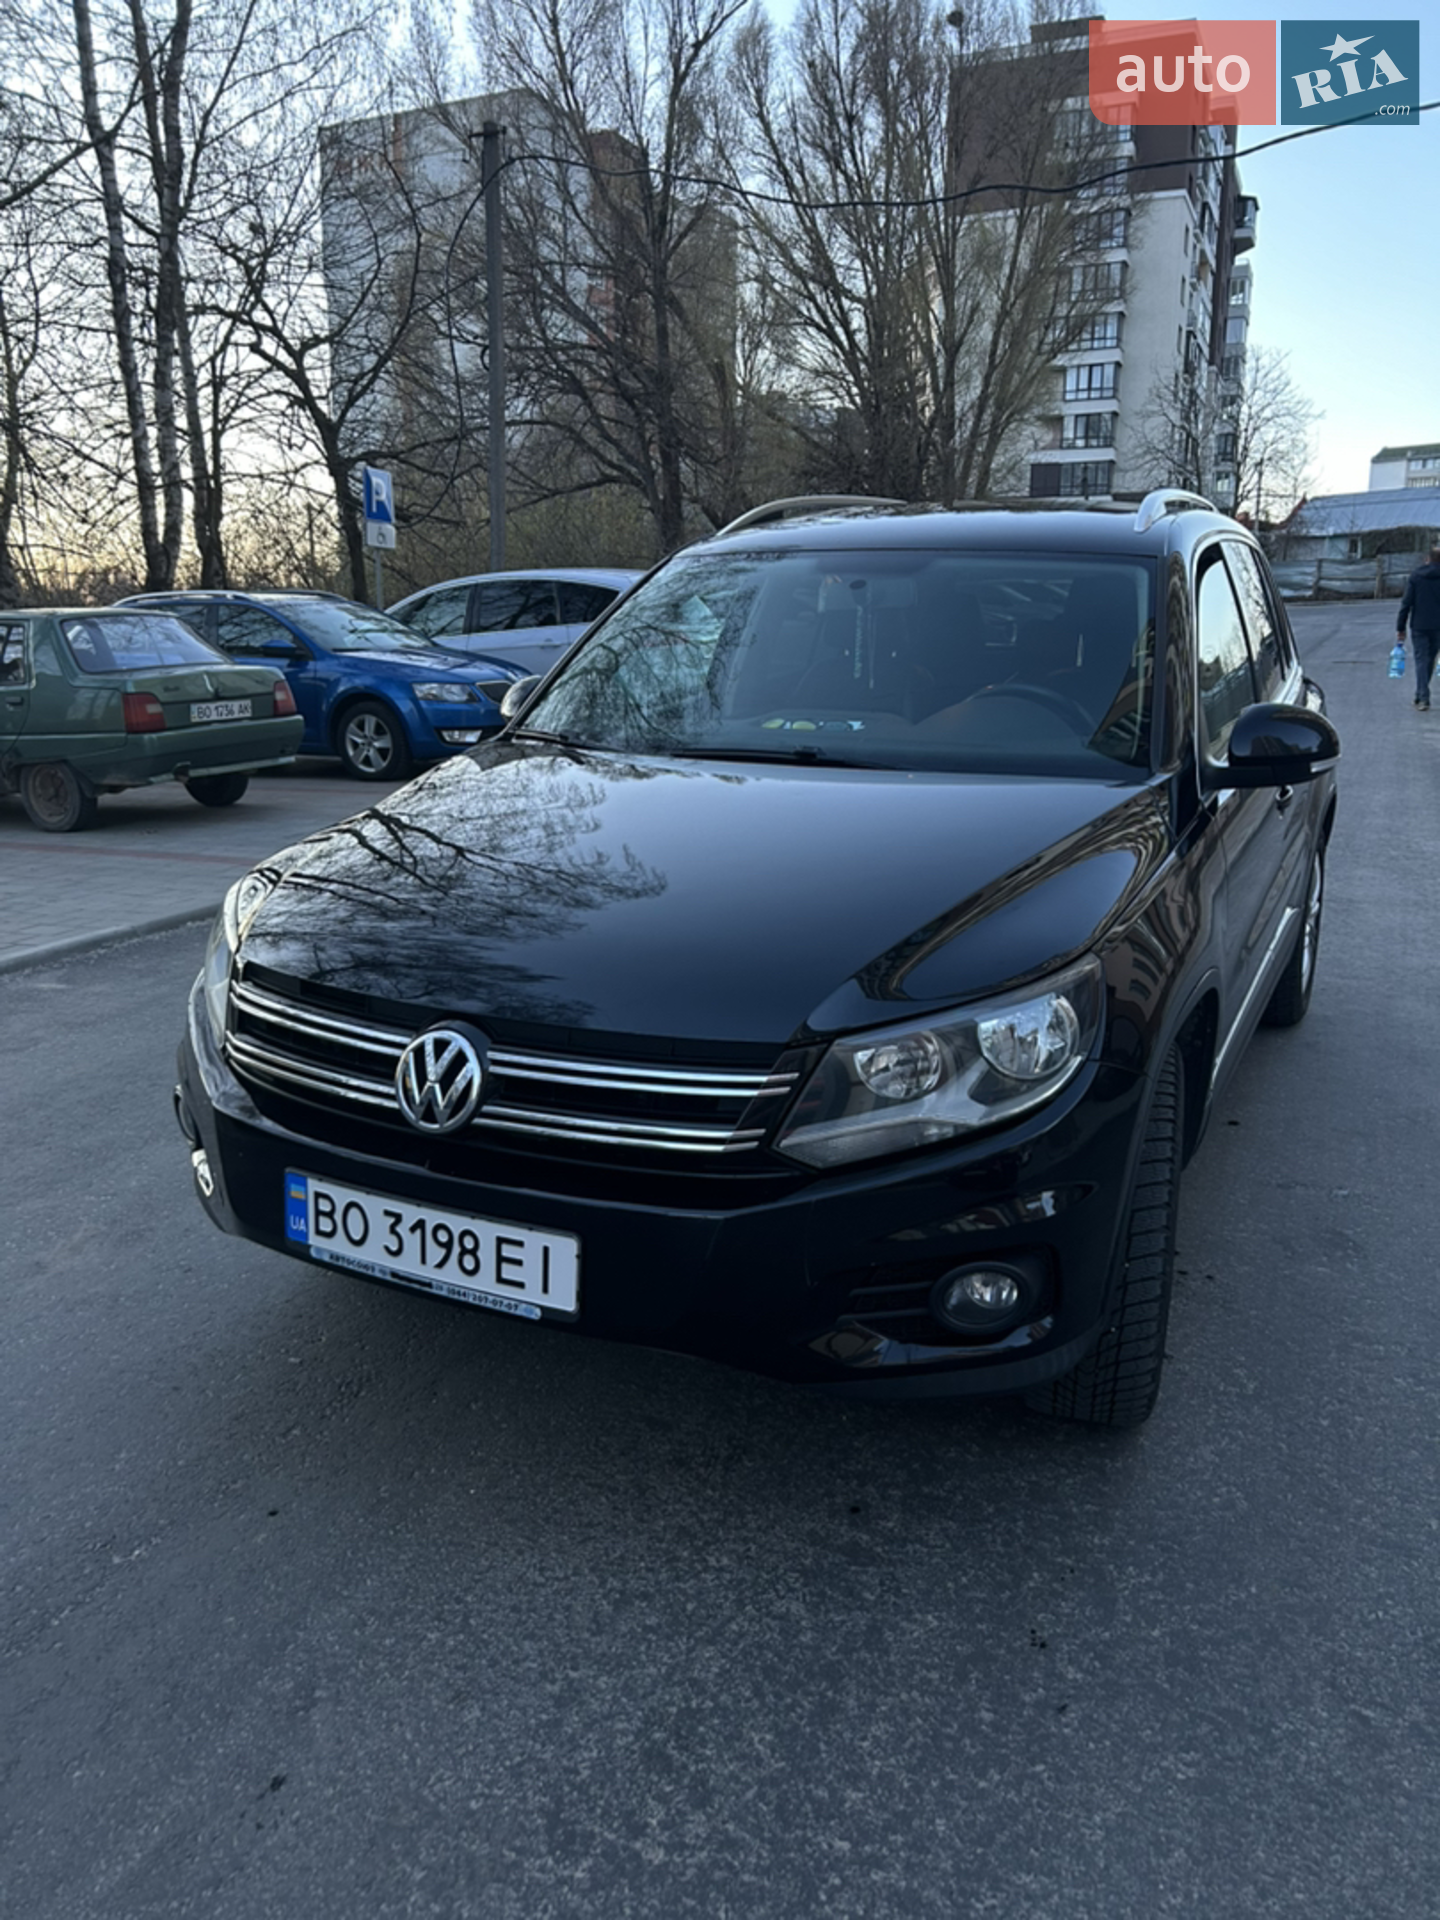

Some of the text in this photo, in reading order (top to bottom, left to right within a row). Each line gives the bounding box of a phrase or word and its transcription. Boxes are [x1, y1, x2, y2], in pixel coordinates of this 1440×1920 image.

[371, 475, 386, 513] P
[197, 706, 212, 719] BO
[214, 703, 235, 717] 1736
[403, 1034, 478, 1129] VW
[290, 1215, 307, 1233] UA
[314, 1190, 550, 1295] BO 3198 EI
